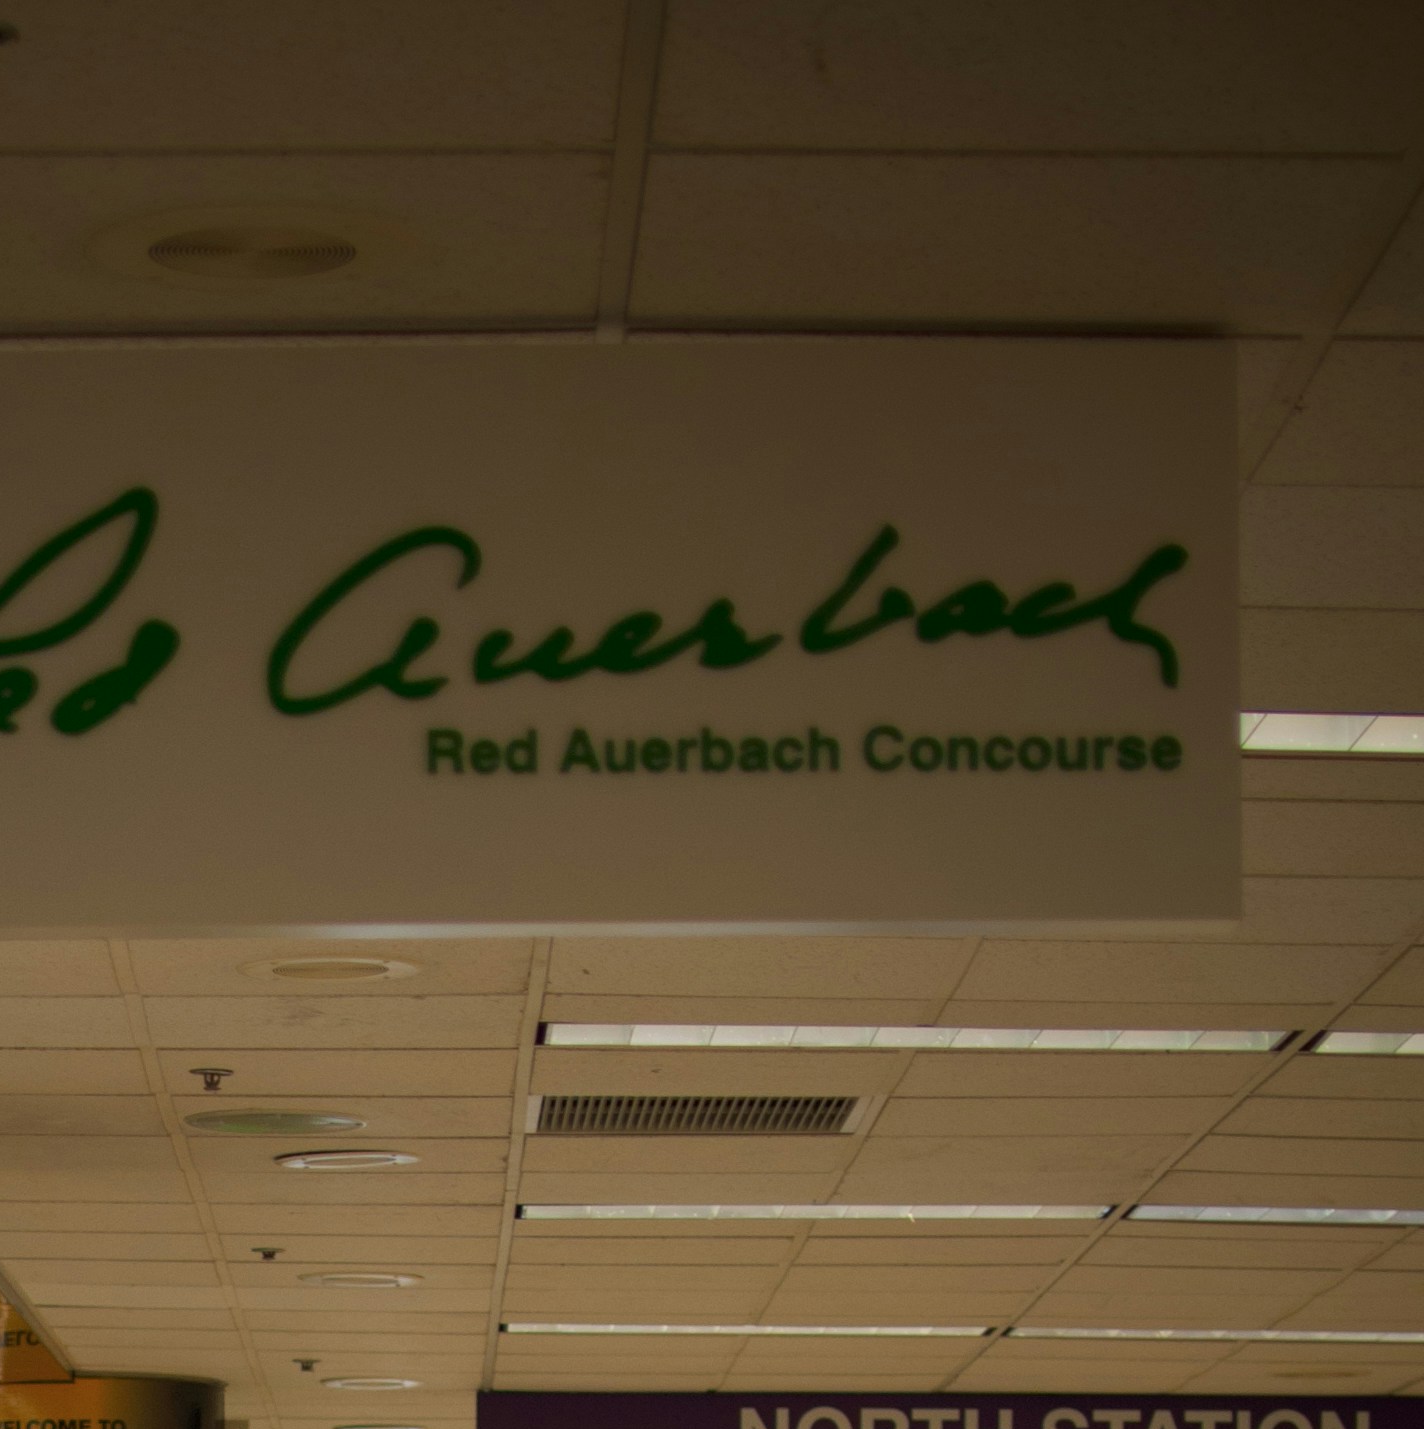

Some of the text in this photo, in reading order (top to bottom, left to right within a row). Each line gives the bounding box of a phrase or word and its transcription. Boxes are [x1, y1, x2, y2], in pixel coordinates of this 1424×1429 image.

[426, 726, 1181, 775] Red Auerbach Concourse
